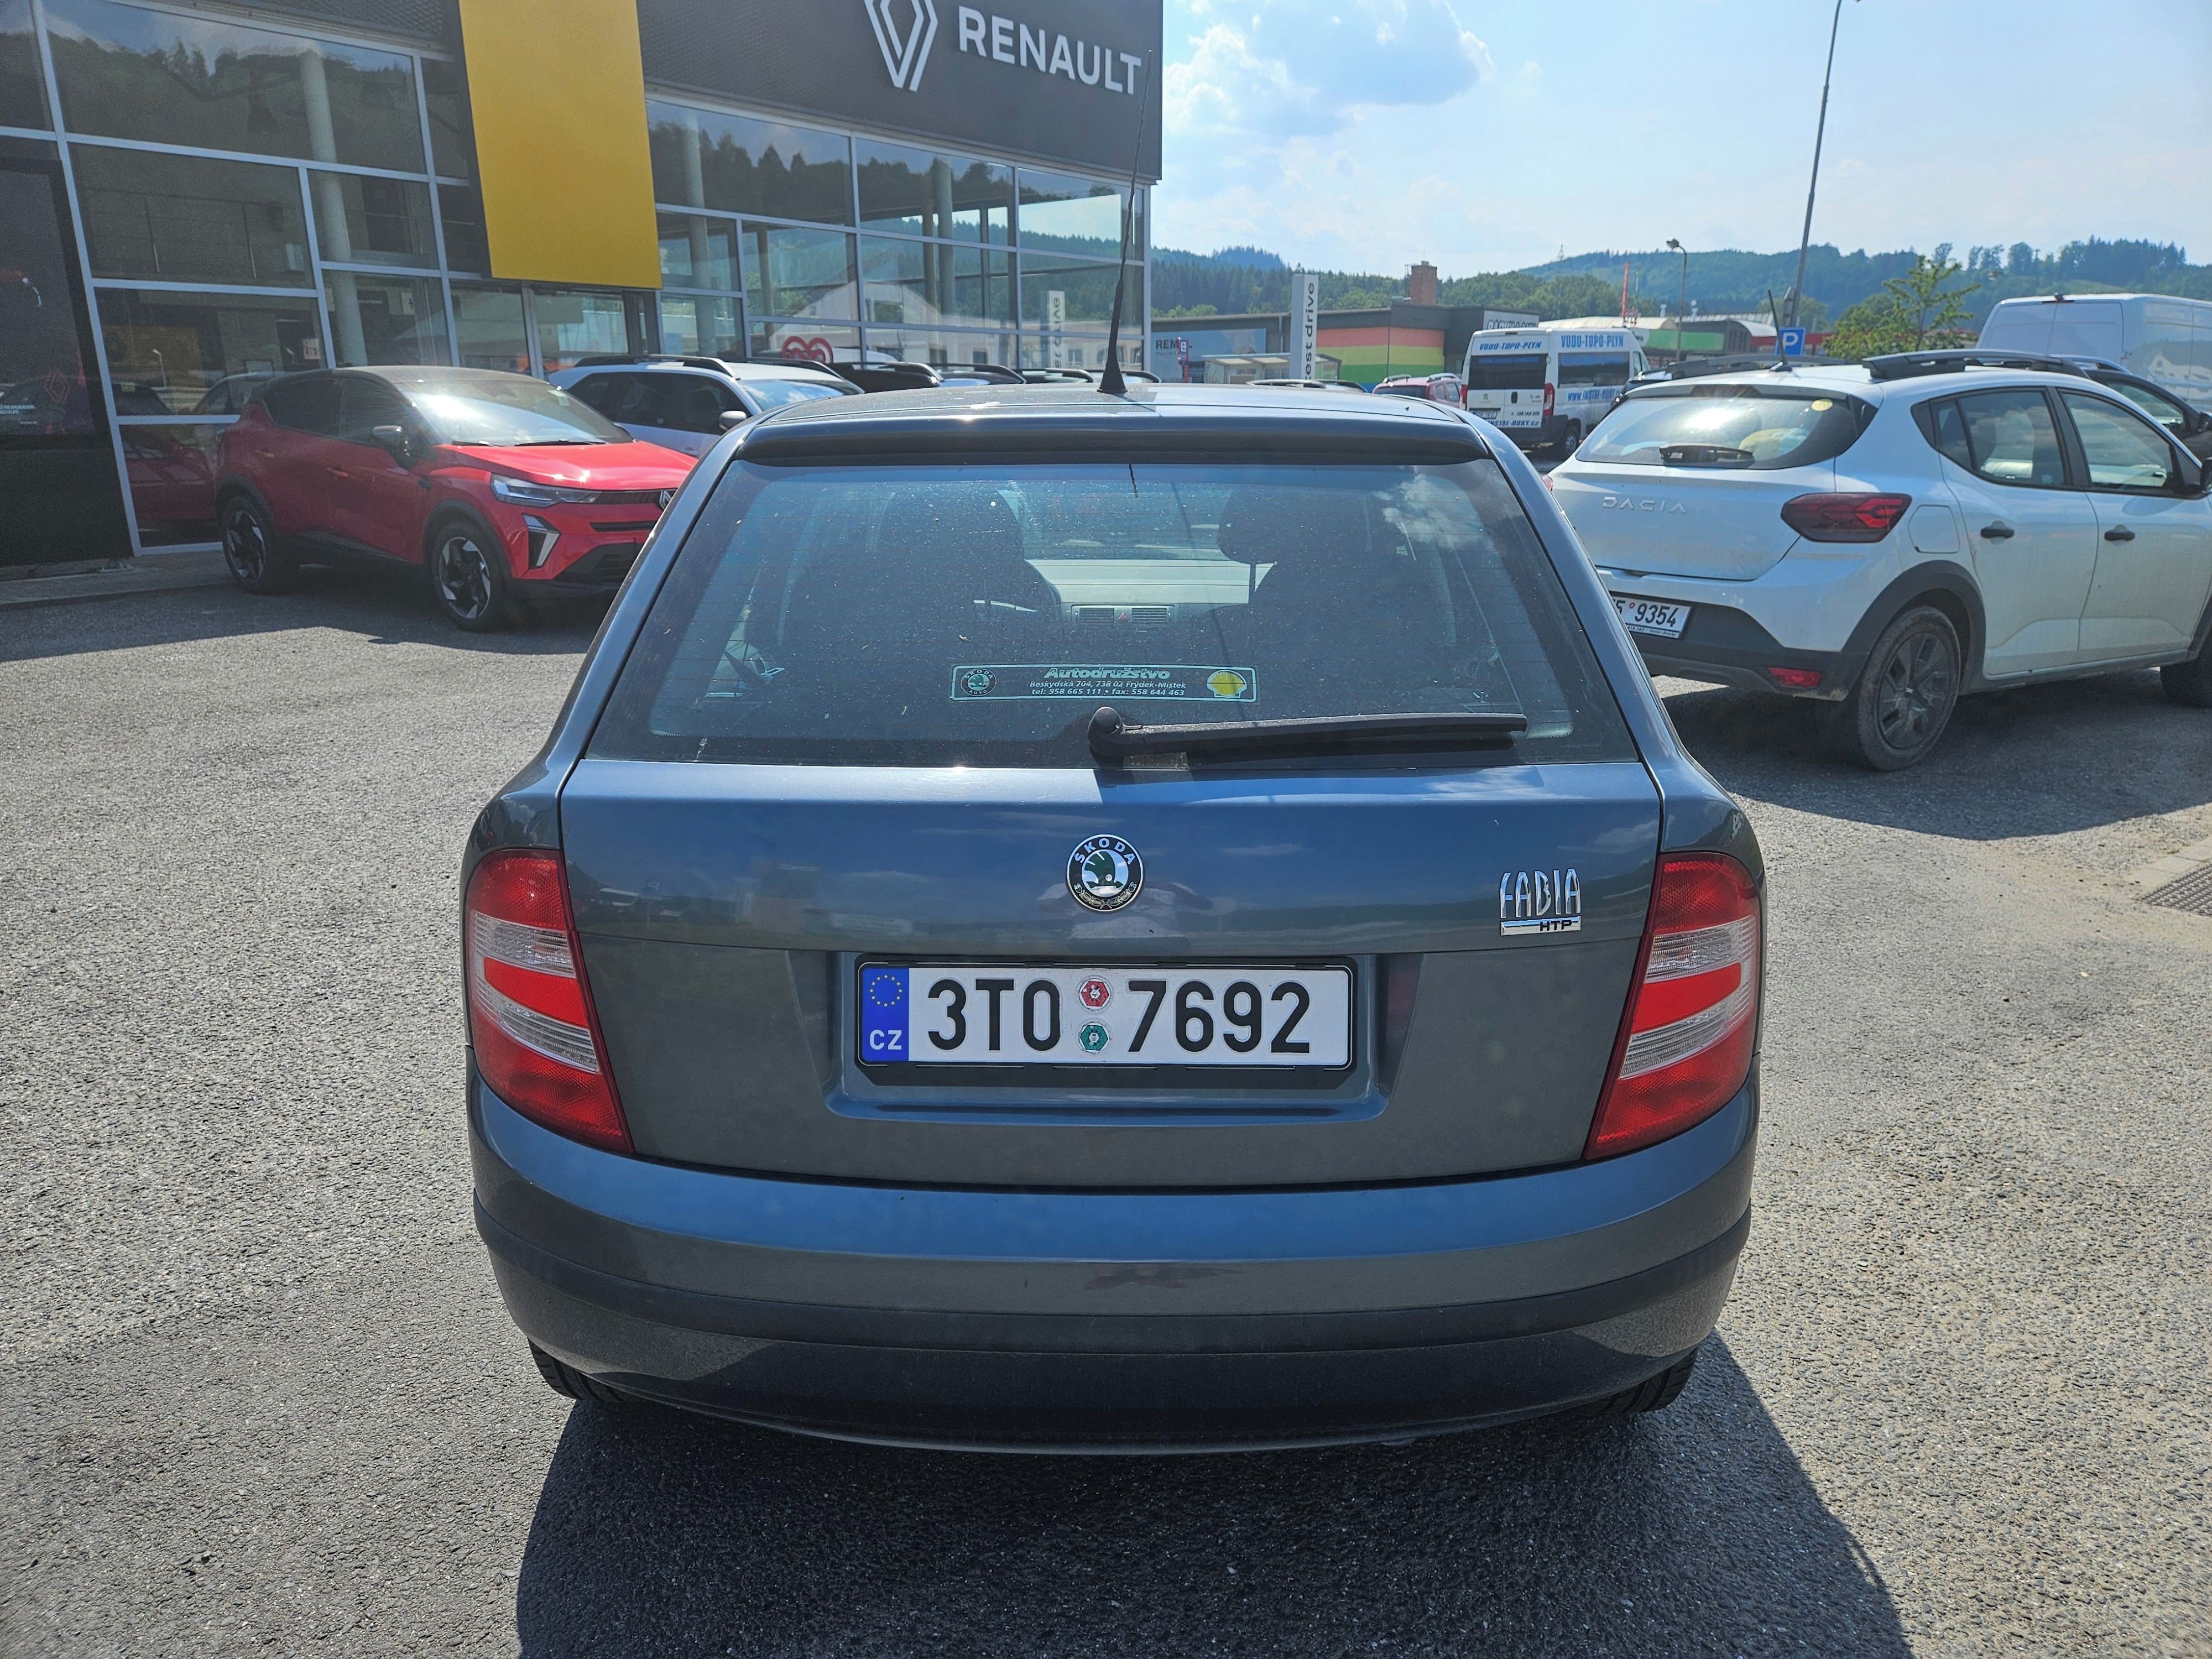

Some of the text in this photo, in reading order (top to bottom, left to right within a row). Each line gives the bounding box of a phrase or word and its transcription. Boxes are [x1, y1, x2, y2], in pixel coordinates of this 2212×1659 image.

[959, 6, 1141, 95] RENAULT
[1305, 282, 1314, 337] drive
[1782, 332, 1799, 349] P
[1603, 496, 1686, 513] DACIA
[1635, 603, 1678, 627] 9354
[1044, 667, 1171, 680] Autodružstvo
[1500, 868, 1581, 918] FABIA
[1540, 920, 1572, 932] HTP
[928, 979, 1310, 1053] 3T0 7692
[870, 1030, 902, 1050] CZ
